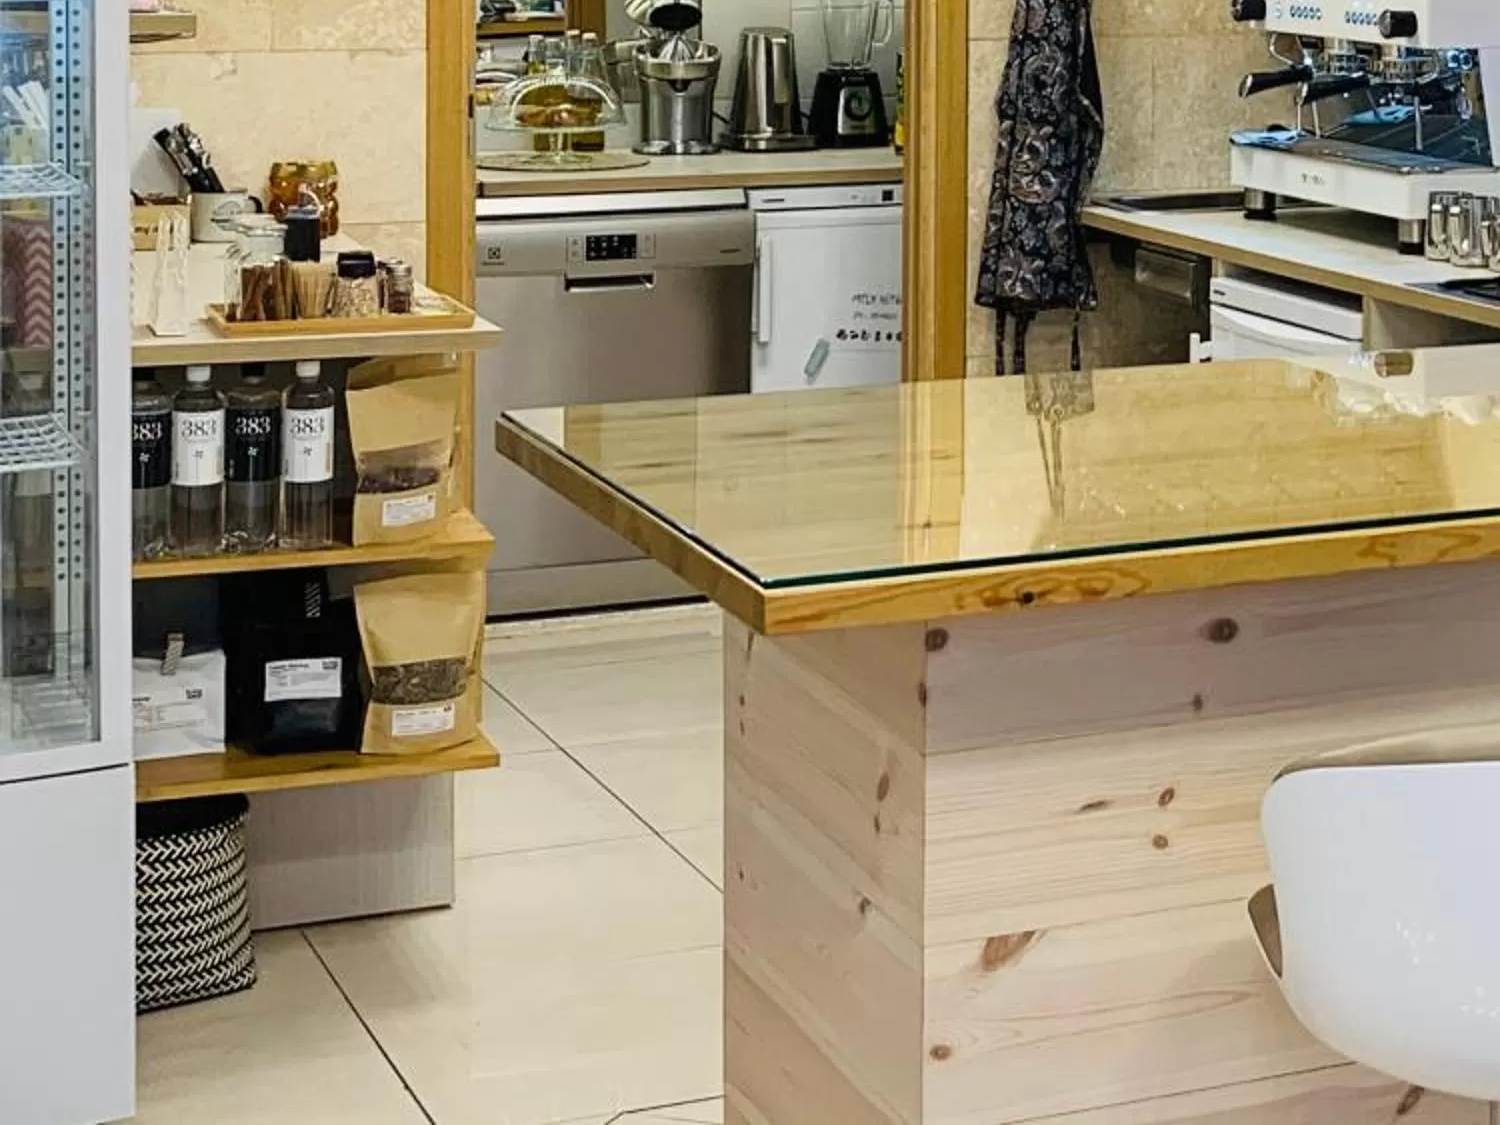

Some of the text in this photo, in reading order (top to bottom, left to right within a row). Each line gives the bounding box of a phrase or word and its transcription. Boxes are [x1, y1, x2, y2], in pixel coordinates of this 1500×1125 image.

[181, 418, 217, 437] 383
[235, 416, 271, 436] 383
[289, 416, 325, 435] 383
